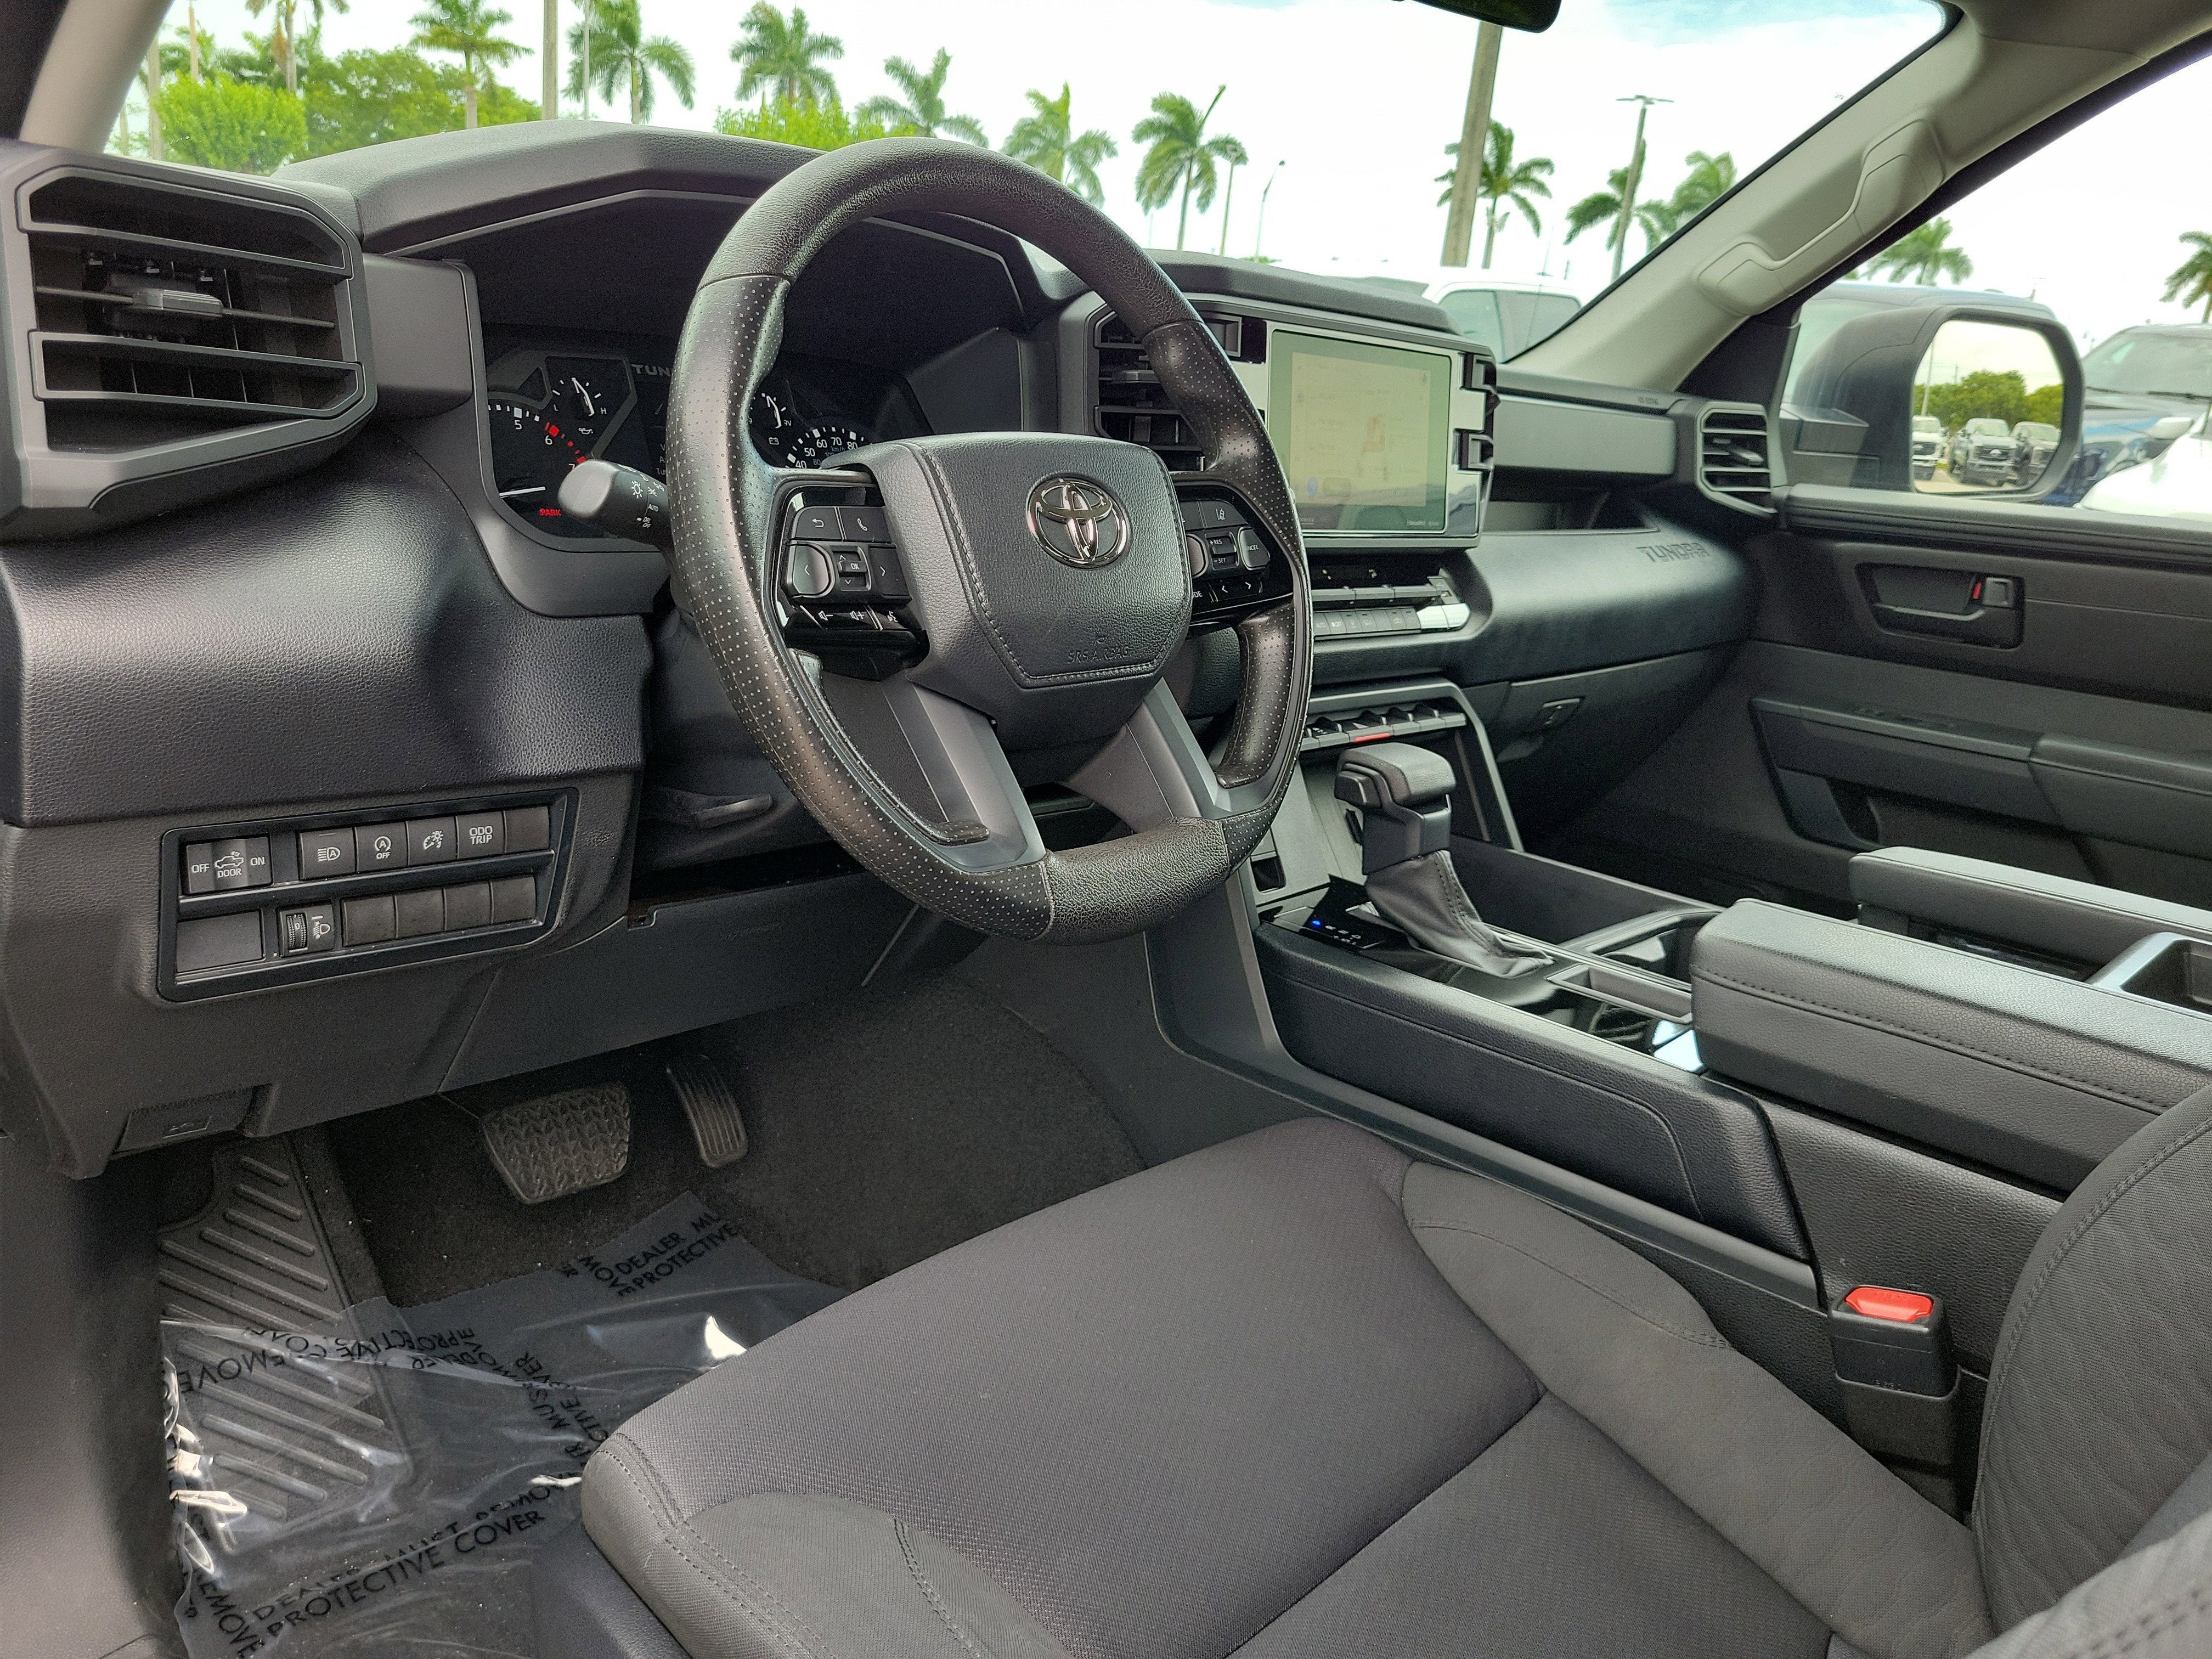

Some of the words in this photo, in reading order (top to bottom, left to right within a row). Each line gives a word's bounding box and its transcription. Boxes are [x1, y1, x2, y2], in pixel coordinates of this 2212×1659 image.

[631, 363, 673, 377] TUN
[514, 420, 522, 430] 5
[545, 435, 552, 445] 6
[816, 439, 827, 448] 60
[831, 437, 842, 446] 70
[847, 441, 858, 450] 80
[804, 447, 815, 456] 50
[795, 460, 807, 469] 40
[539, 507, 562, 516] PARK
[648, 504, 659, 512] AUTO
[470, 825, 493, 836] ODO
[471, 834, 493, 845] TRIP
[250, 856, 265, 866] ON
[191, 863, 210, 873] OFF
[217, 868, 242, 878] DOOR
[614, 1232, 686, 1276] DEALER
[267, 1546, 444, 1637] PROTECTIVE
[454, 1510, 546, 1553] COVER
